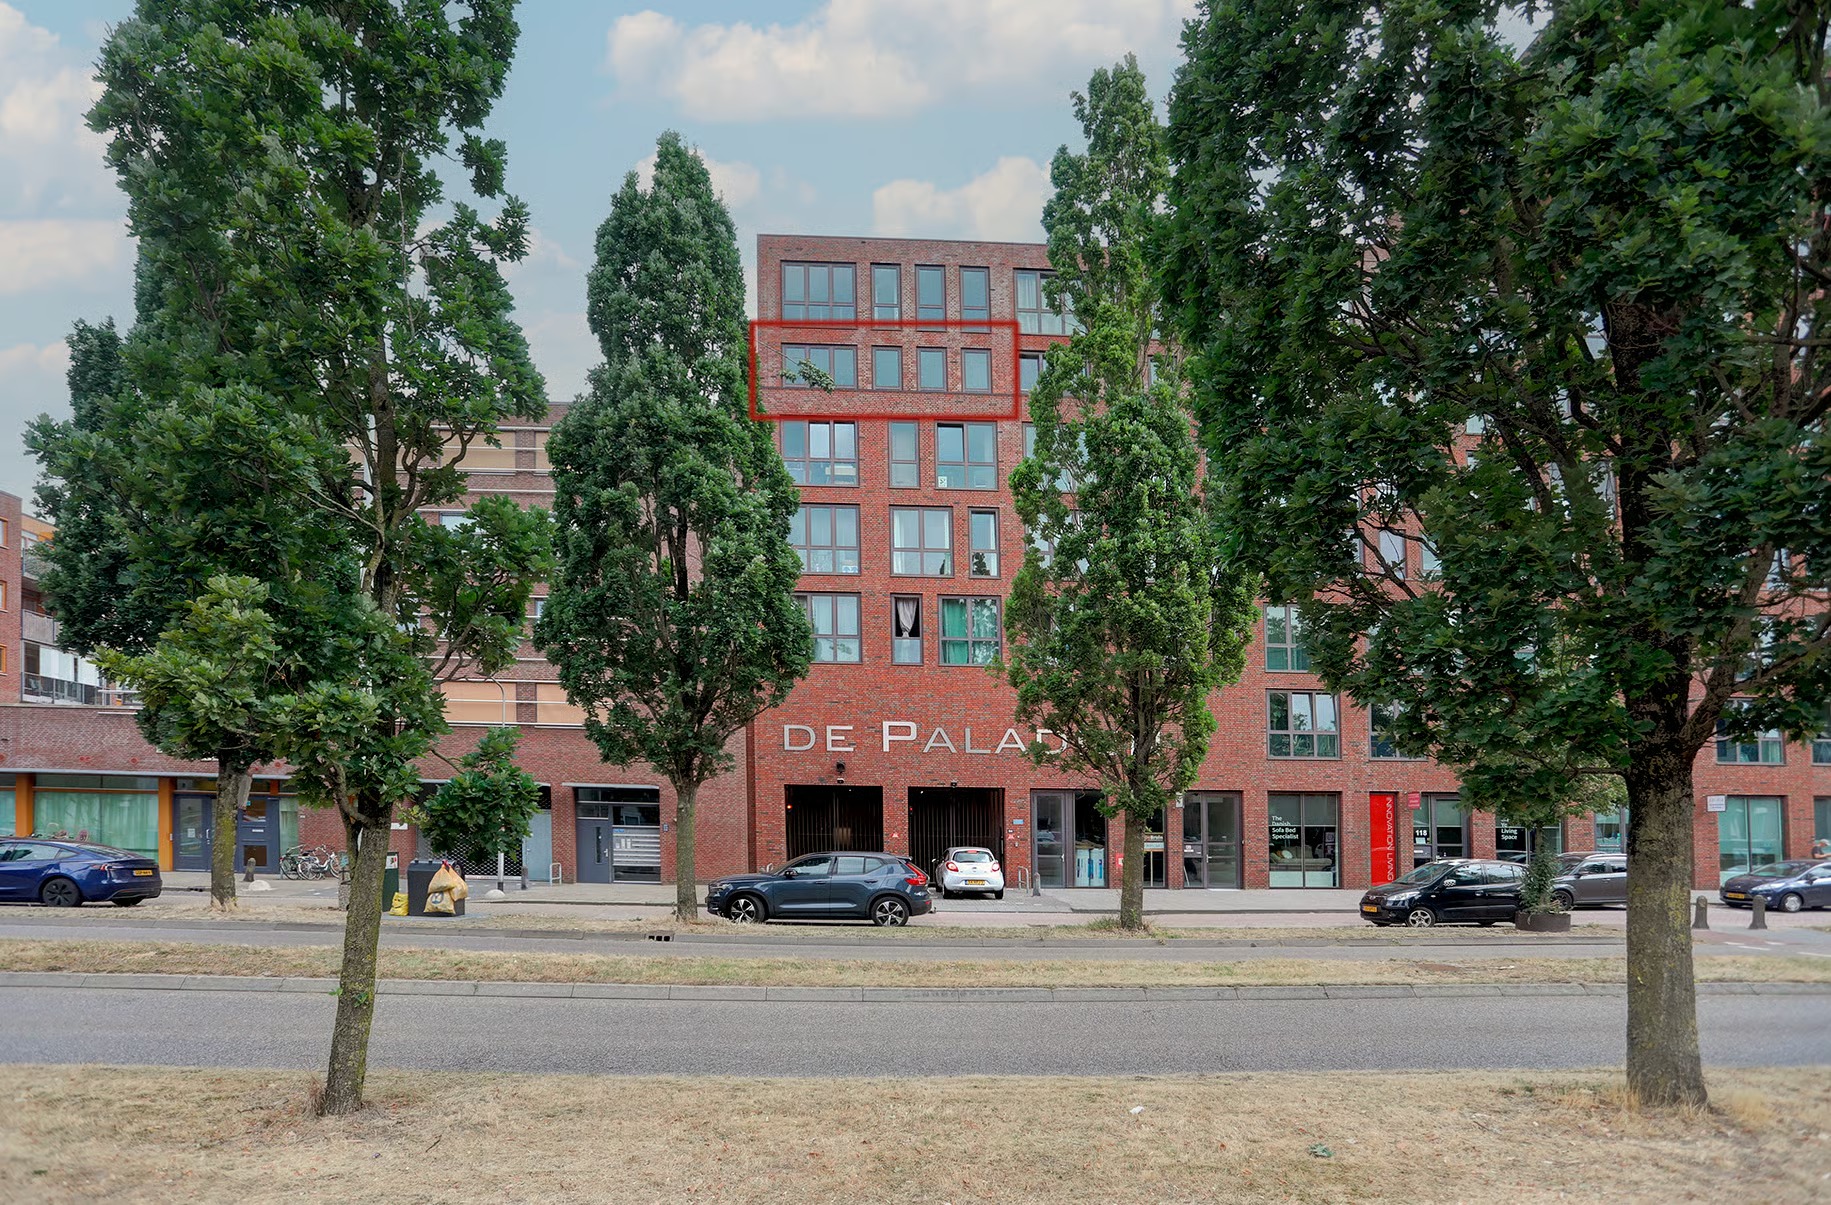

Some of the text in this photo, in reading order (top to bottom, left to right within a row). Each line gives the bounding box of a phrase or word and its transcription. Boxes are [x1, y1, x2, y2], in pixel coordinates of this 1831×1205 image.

[784, 724, 855, 752] DE
[1386, 796, 1395, 881] INNOVATION LIVING
[1415, 829, 1428, 837] 118
